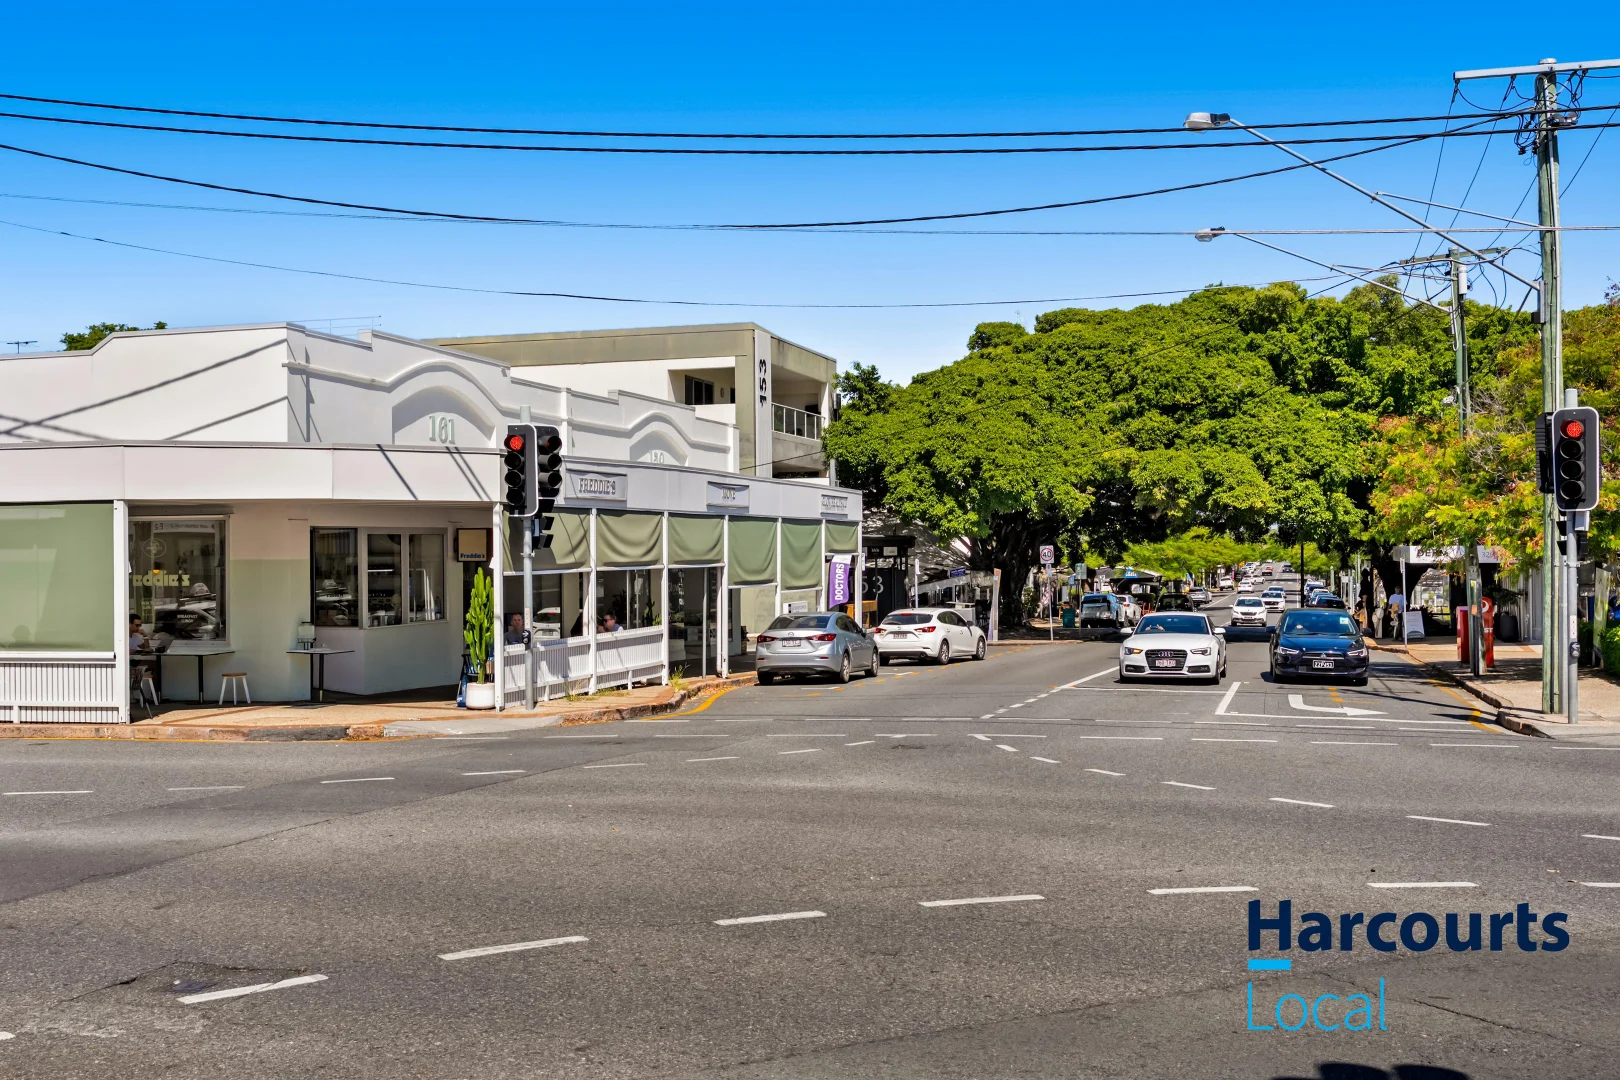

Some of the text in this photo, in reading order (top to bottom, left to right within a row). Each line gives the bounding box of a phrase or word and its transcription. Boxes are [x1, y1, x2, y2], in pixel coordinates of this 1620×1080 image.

[759, 359, 767, 407] 153
[428, 415, 456, 445] 161
[578, 477, 617, 495] FREDDIE'S
[1042, 550, 1052, 559] 40
[131, 569, 190, 587] eddie's
[834, 563, 845, 601] DOCTORS
